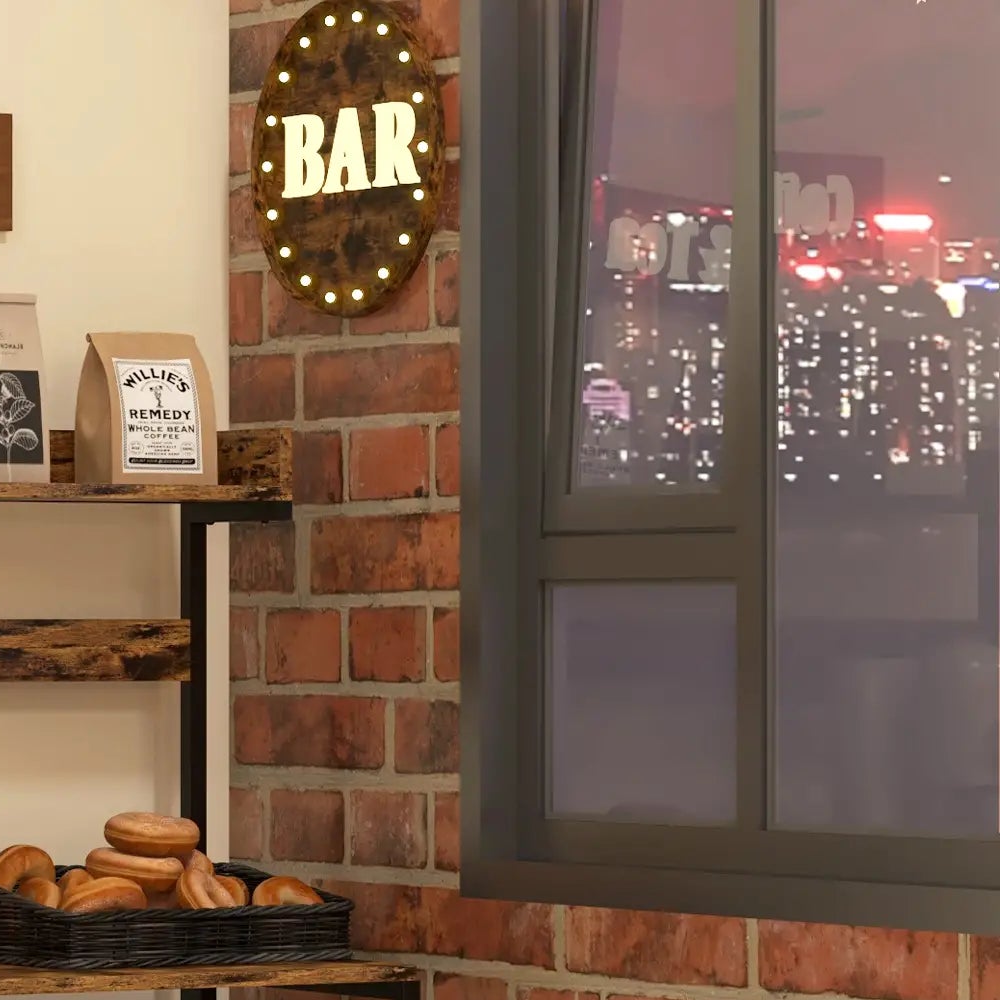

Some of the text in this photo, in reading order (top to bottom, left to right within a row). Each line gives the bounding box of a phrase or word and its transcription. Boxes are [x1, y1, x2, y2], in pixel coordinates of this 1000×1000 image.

[281, 101, 421, 199] BAR
[122, 367, 191, 393] WILLIE'S
[129, 409, 191, 420] REMEDY
[128, 424, 195, 433] WHOLE BEAN
